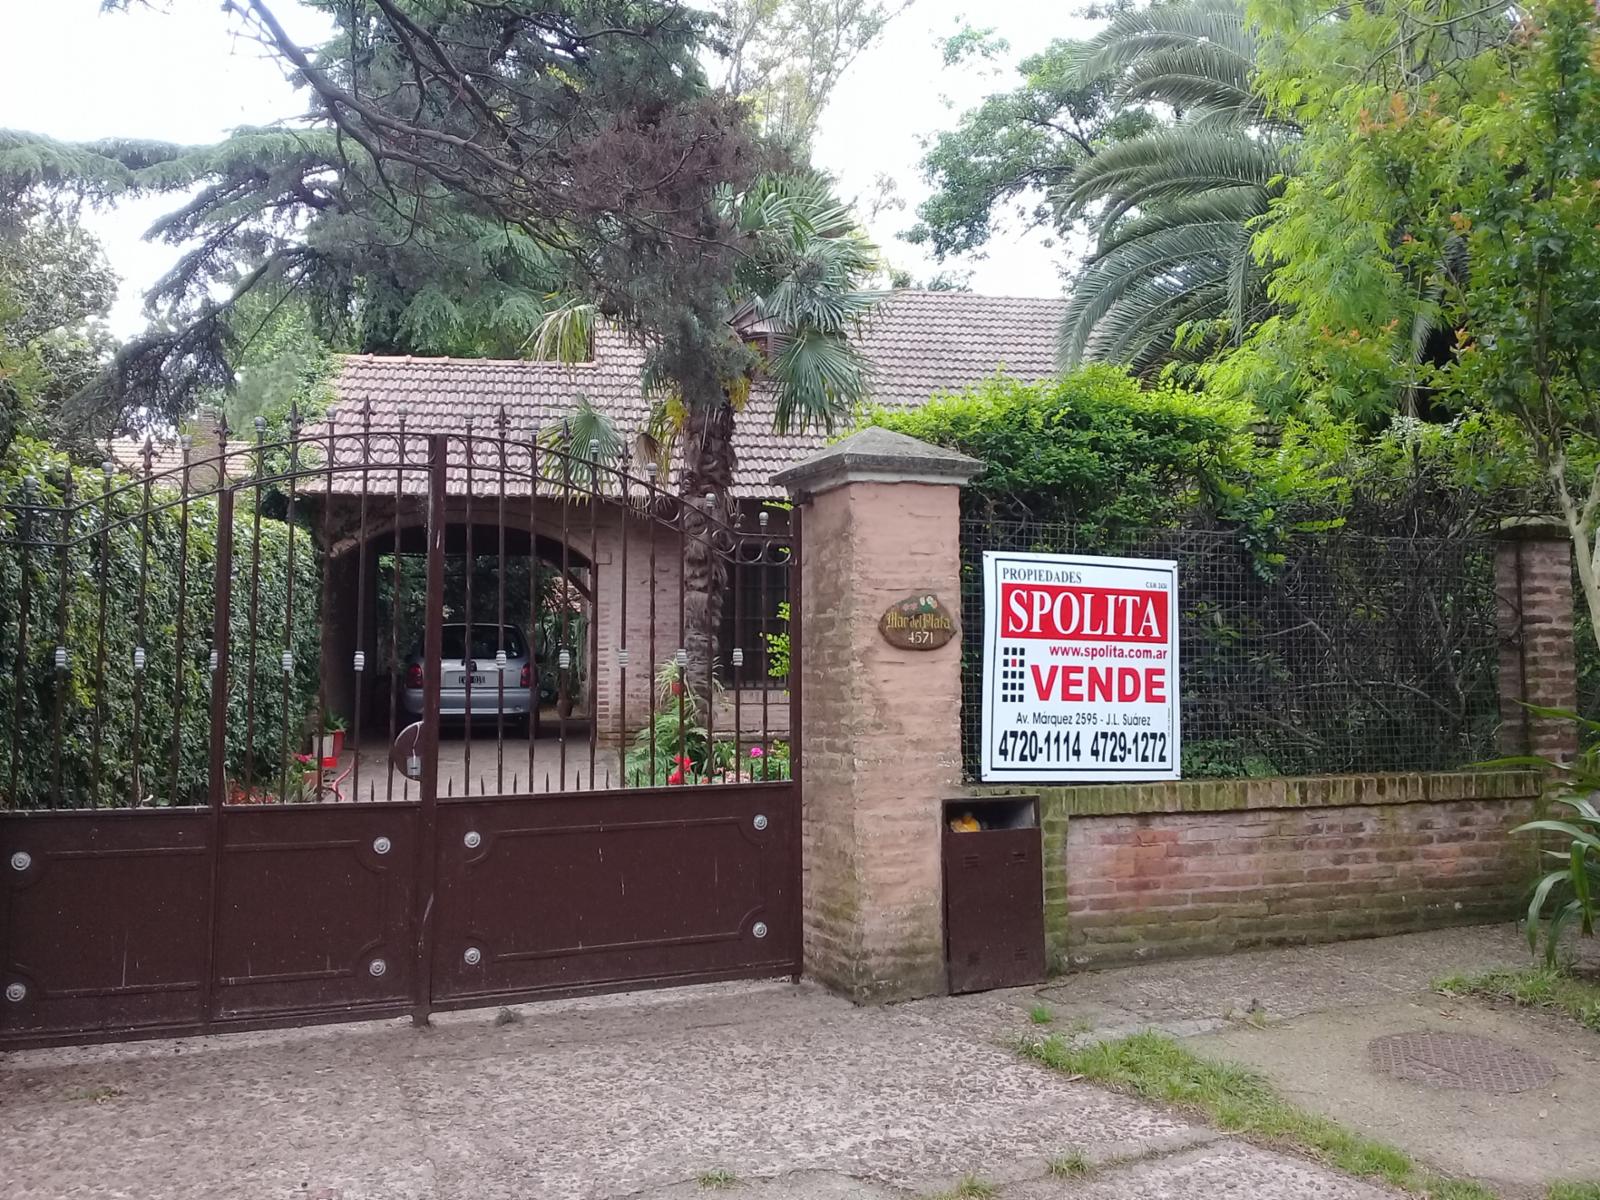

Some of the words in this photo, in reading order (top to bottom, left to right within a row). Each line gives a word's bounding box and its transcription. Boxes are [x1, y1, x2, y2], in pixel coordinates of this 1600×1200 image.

[1002, 567, 1082, 584] PROPIEDADES
[886, 611, 909, 630] Mar
[909, 615, 922, 629] del
[922, 613, 951, 631] Plata
[1008, 588, 1162, 638] SPOLITA
[908, 631, 934, 644] 4571
[1049, 644, 1168, 661] www.spolita.com.ar
[1030, 664, 1167, 704] VENDE
[1016, 712, 1029, 724] Av.
[1032, 711, 1073, 727] Márquez
[1075, 712, 1098, 725] 2595
[1106, 713, 1120, 726] J.L.
[1122, 711, 1151, 726] Suárez
[998, 730, 1081, 763] 4720-1114
[1090, 731, 1167, 763] 4729-1272
